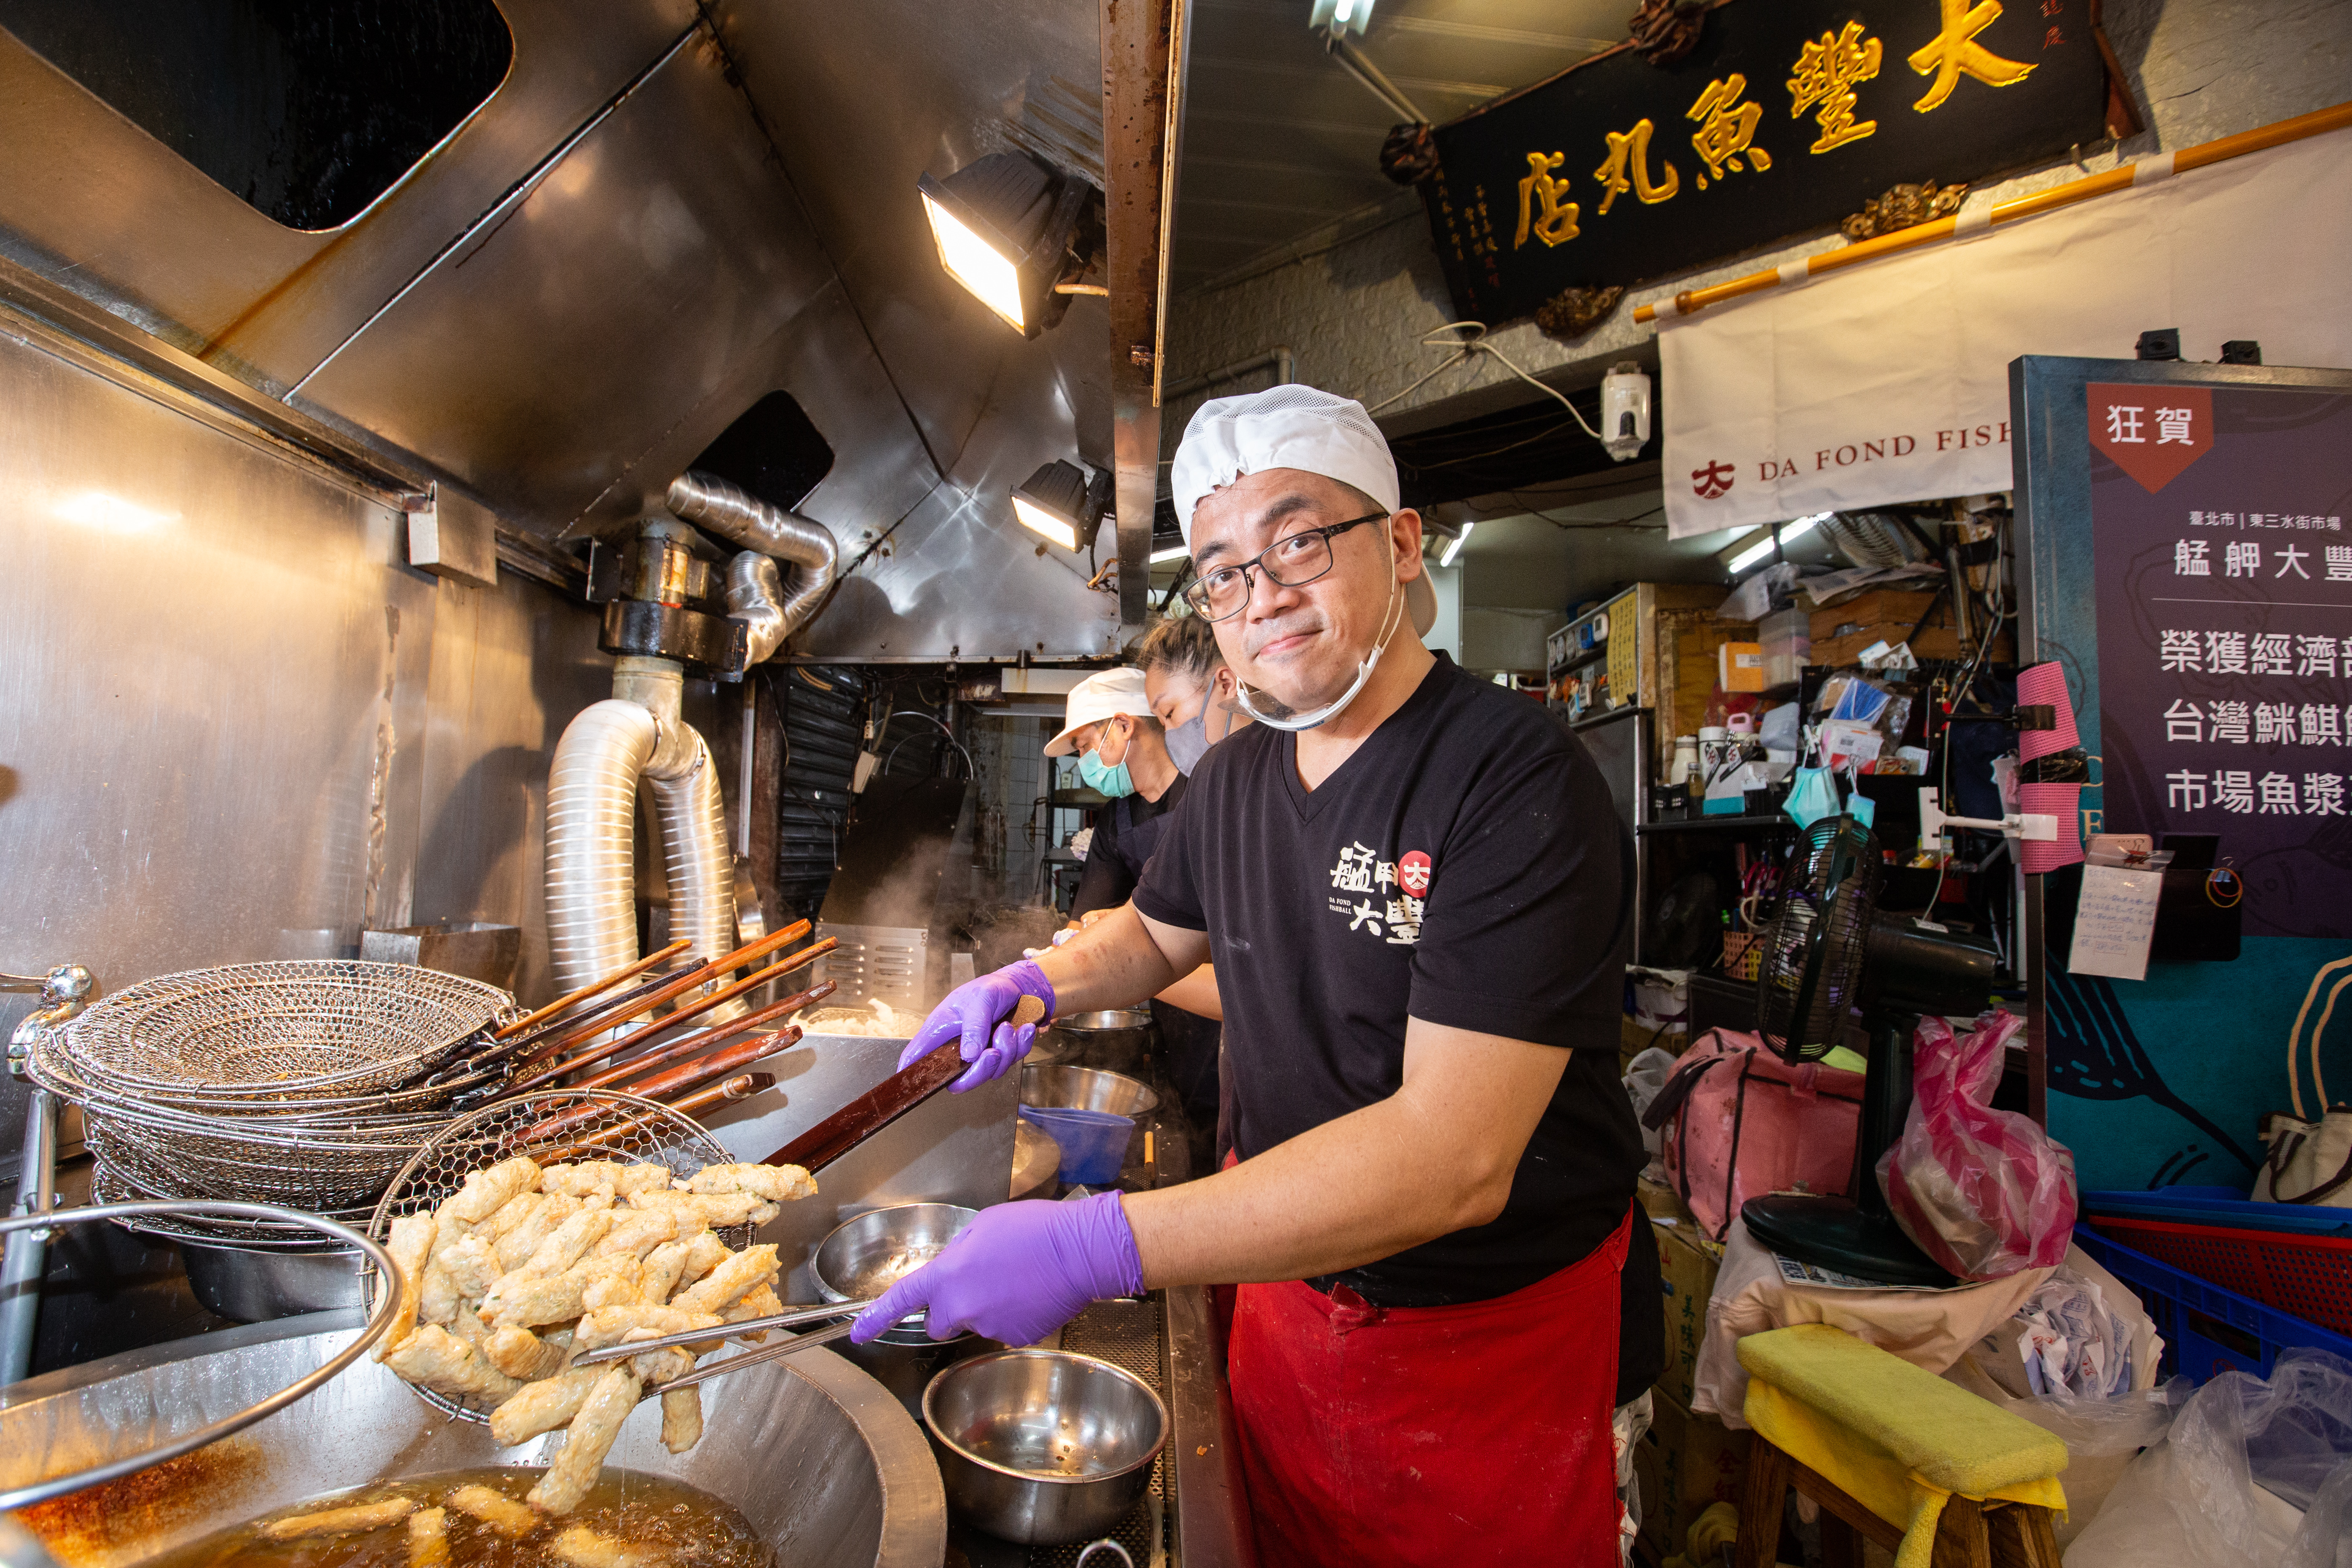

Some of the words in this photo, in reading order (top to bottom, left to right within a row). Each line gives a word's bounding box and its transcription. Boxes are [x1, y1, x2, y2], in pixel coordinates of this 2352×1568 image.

[2106, 405, 2195, 446] 狂賀
[1759, 457, 1799, 482] DA
[1816, 434, 1916, 471] FOND
[2163, 698, 2352, 747] 台灣䱊鯕
[2165, 769, 2352, 816] 市場魚漿
[1329, 904, 1352, 914] FISHBALL
[1337, 898, 1351, 906] FOND
